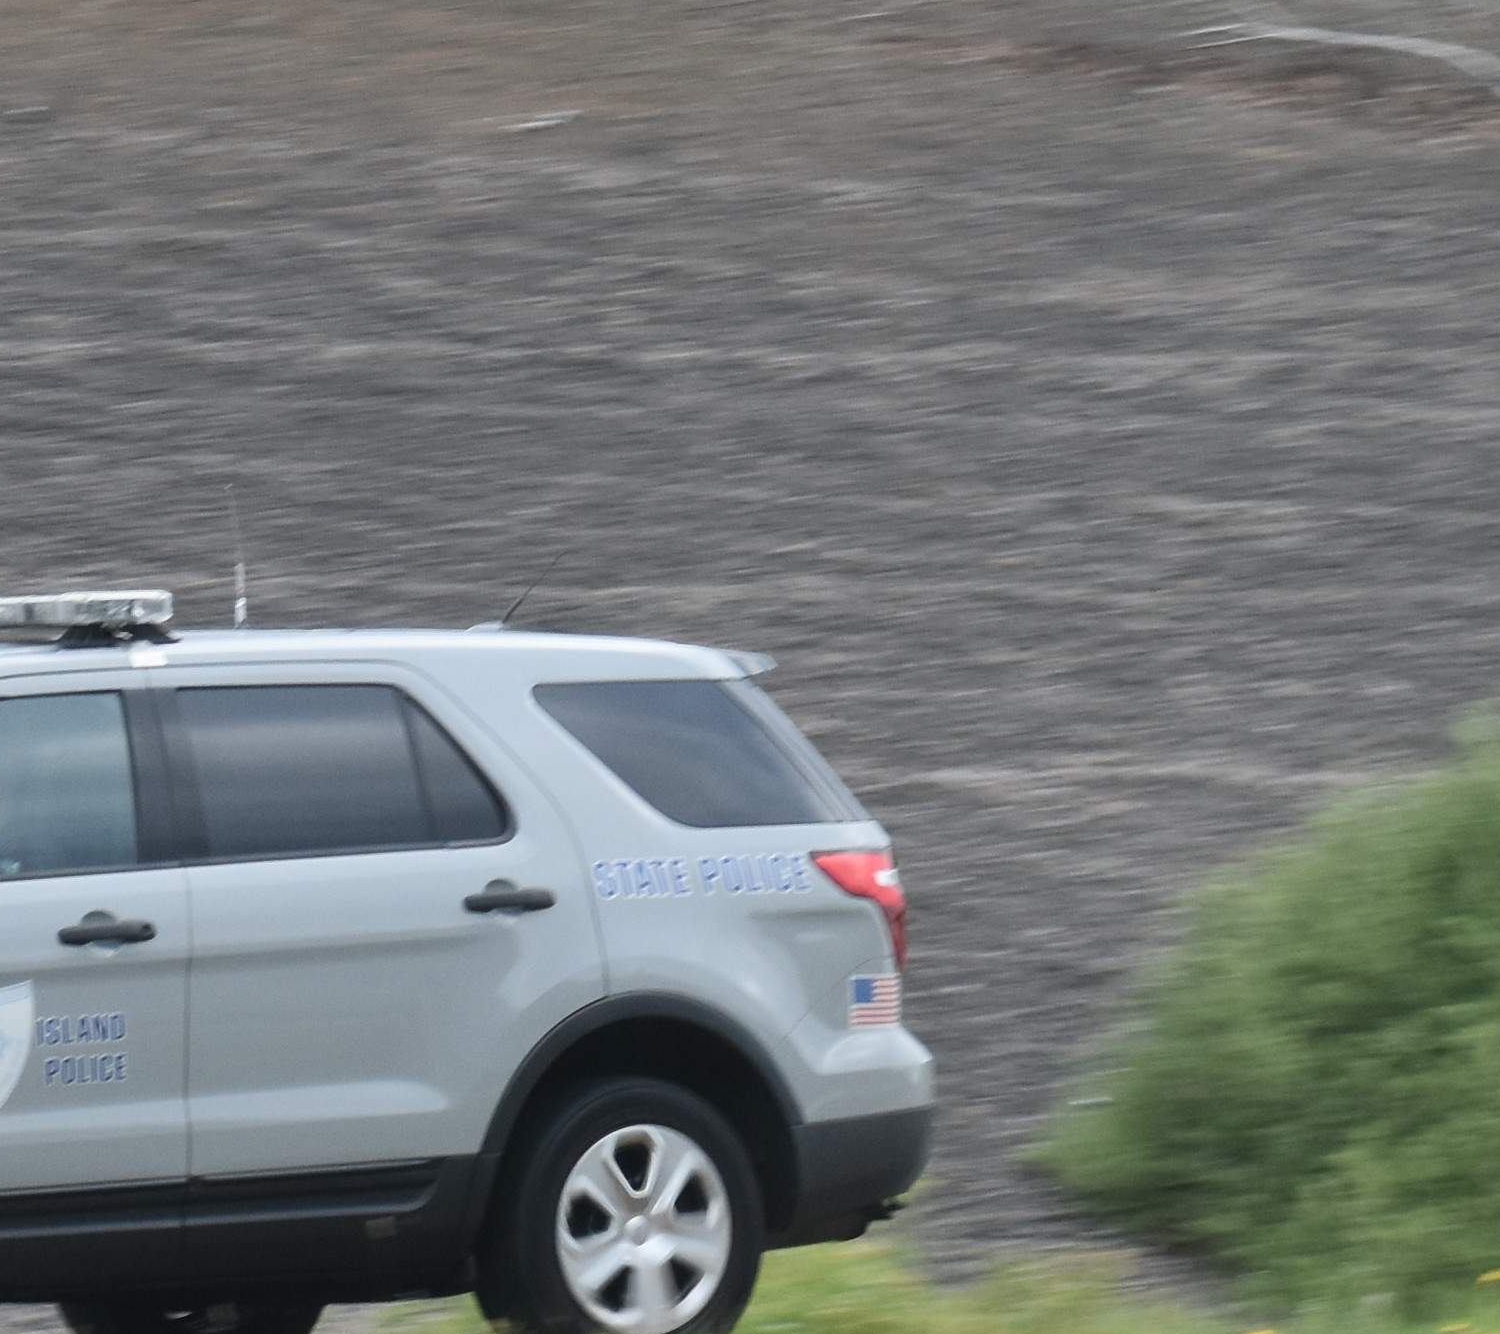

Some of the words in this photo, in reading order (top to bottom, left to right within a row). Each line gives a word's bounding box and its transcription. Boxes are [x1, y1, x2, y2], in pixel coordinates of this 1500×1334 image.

[593, 858, 693, 900] STATE
[698, 851, 813, 895] POLICE
[35, 1012, 128, 1047] ISLAND
[45, 1052, 128, 1086] POLICE
